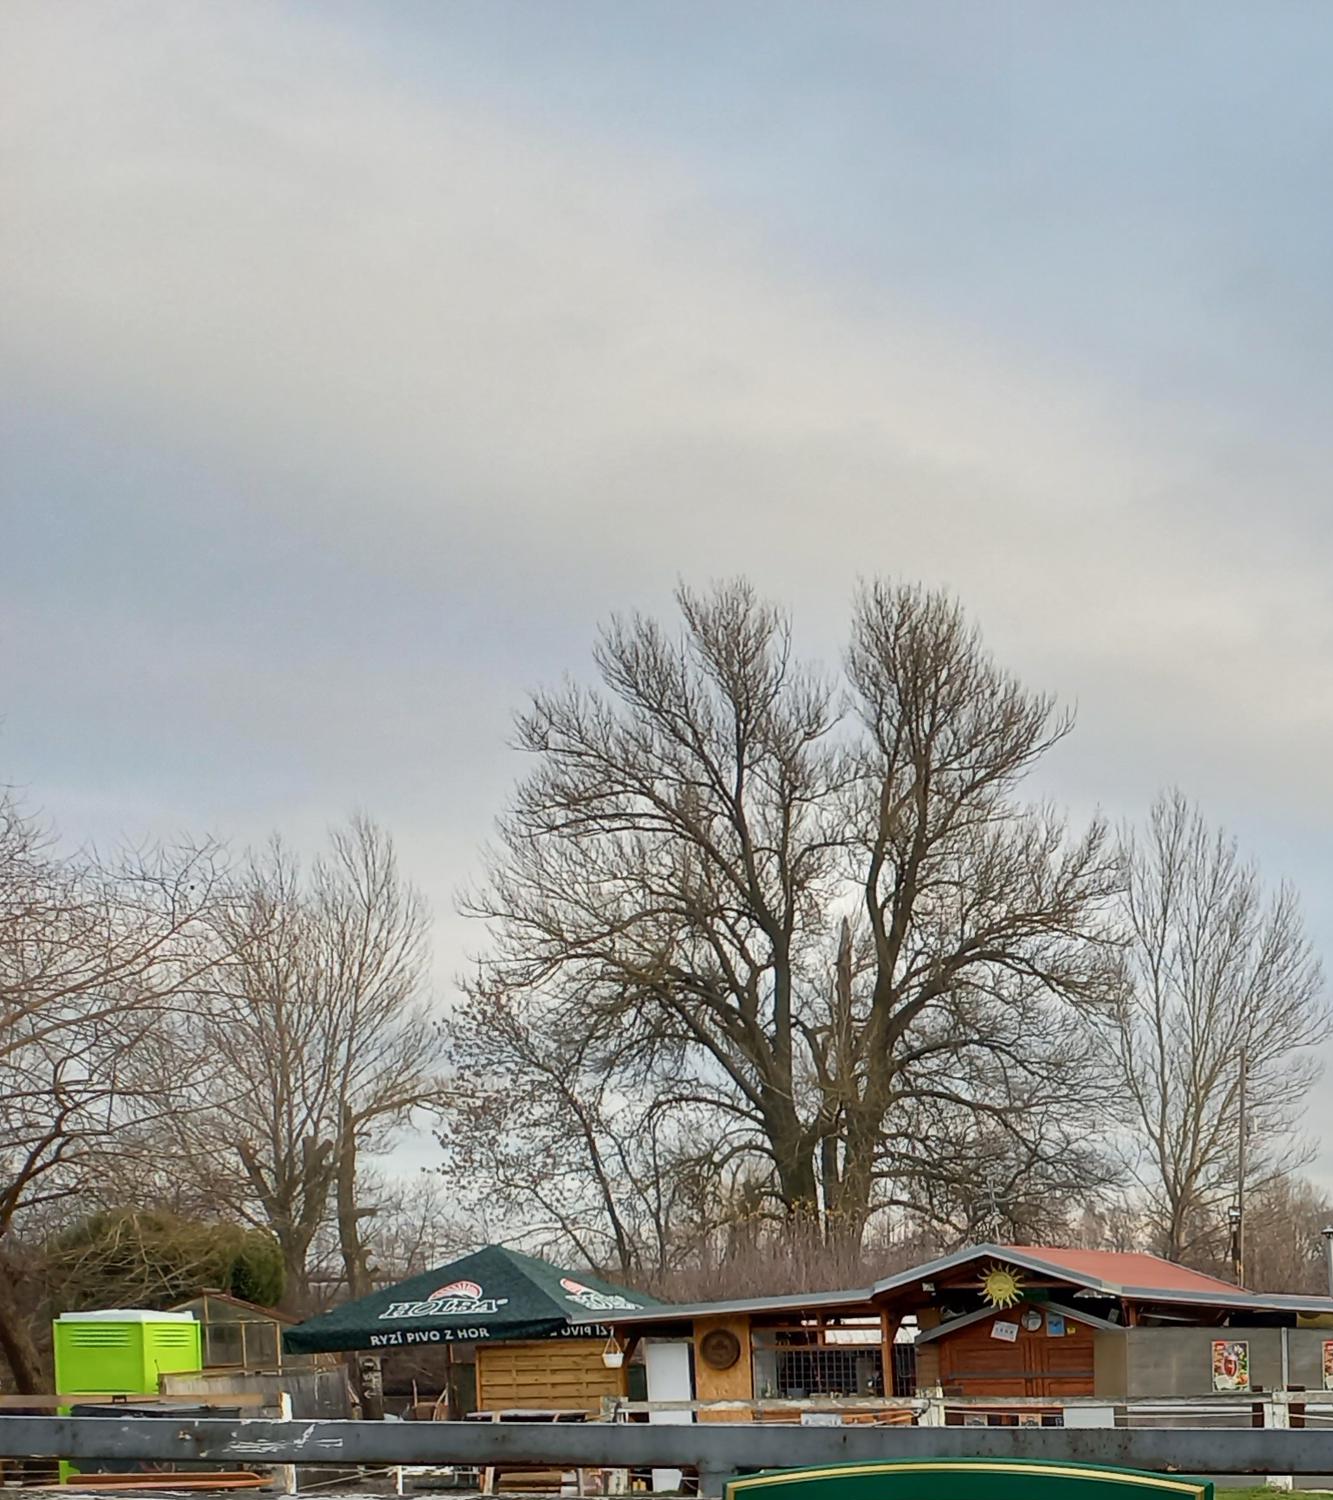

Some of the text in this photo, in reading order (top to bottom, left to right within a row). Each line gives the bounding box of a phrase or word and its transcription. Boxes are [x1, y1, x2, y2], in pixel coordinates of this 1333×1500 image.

[379, 1299, 499, 1320] HOLBA
[370, 1327, 490, 1346] RYZÍ PIVO Z HOR
